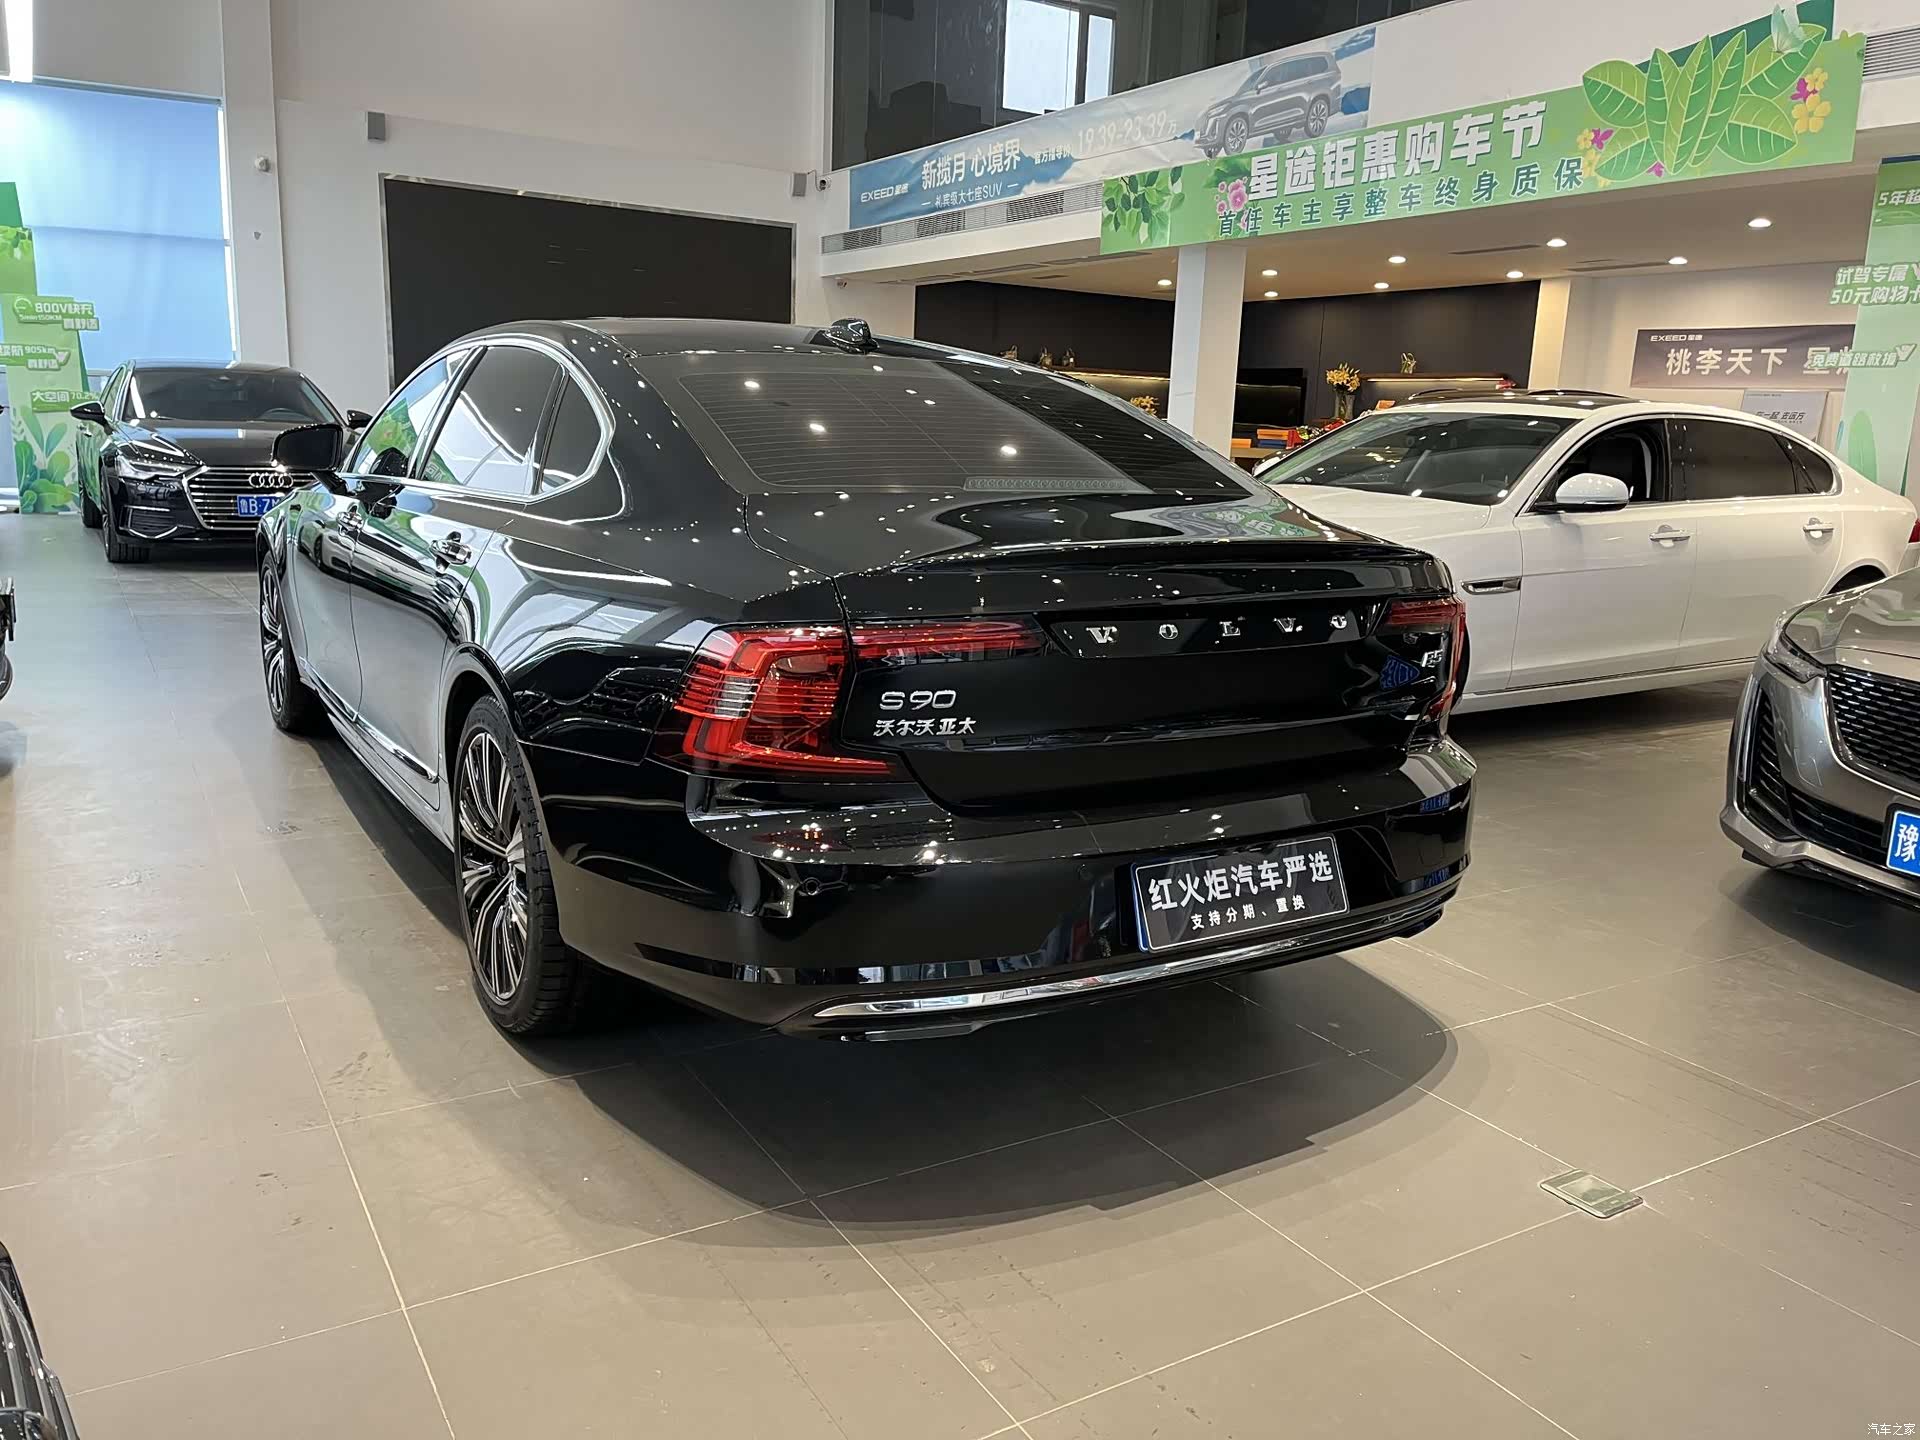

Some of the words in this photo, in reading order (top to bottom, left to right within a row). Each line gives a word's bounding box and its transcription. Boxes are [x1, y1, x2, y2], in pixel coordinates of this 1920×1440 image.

[921, 151, 966, 190] 新揽月
[970, 138, 1022, 178] 心境界
[1248, 100, 1547, 201] 星途钜惠购车节
[860, 186, 894, 203] EXEED
[1217, 156, 1584, 237] 首任车主享整车终身质保
[1836, 264, 1909, 286] 试驾专属
[1650, 334, 1687, 342] EXEED
[1666, 347, 1788, 376] 桃李天下
[32, 391, 70, 403] 大空间
[1086, 614, 1348, 644] VOLVO
[872, 716, 977, 737] 沃尔沃亚太
[1148, 850, 1334, 912] 红火炬汽车严选
[1190, 894, 1306, 931] 支持分期、置换
